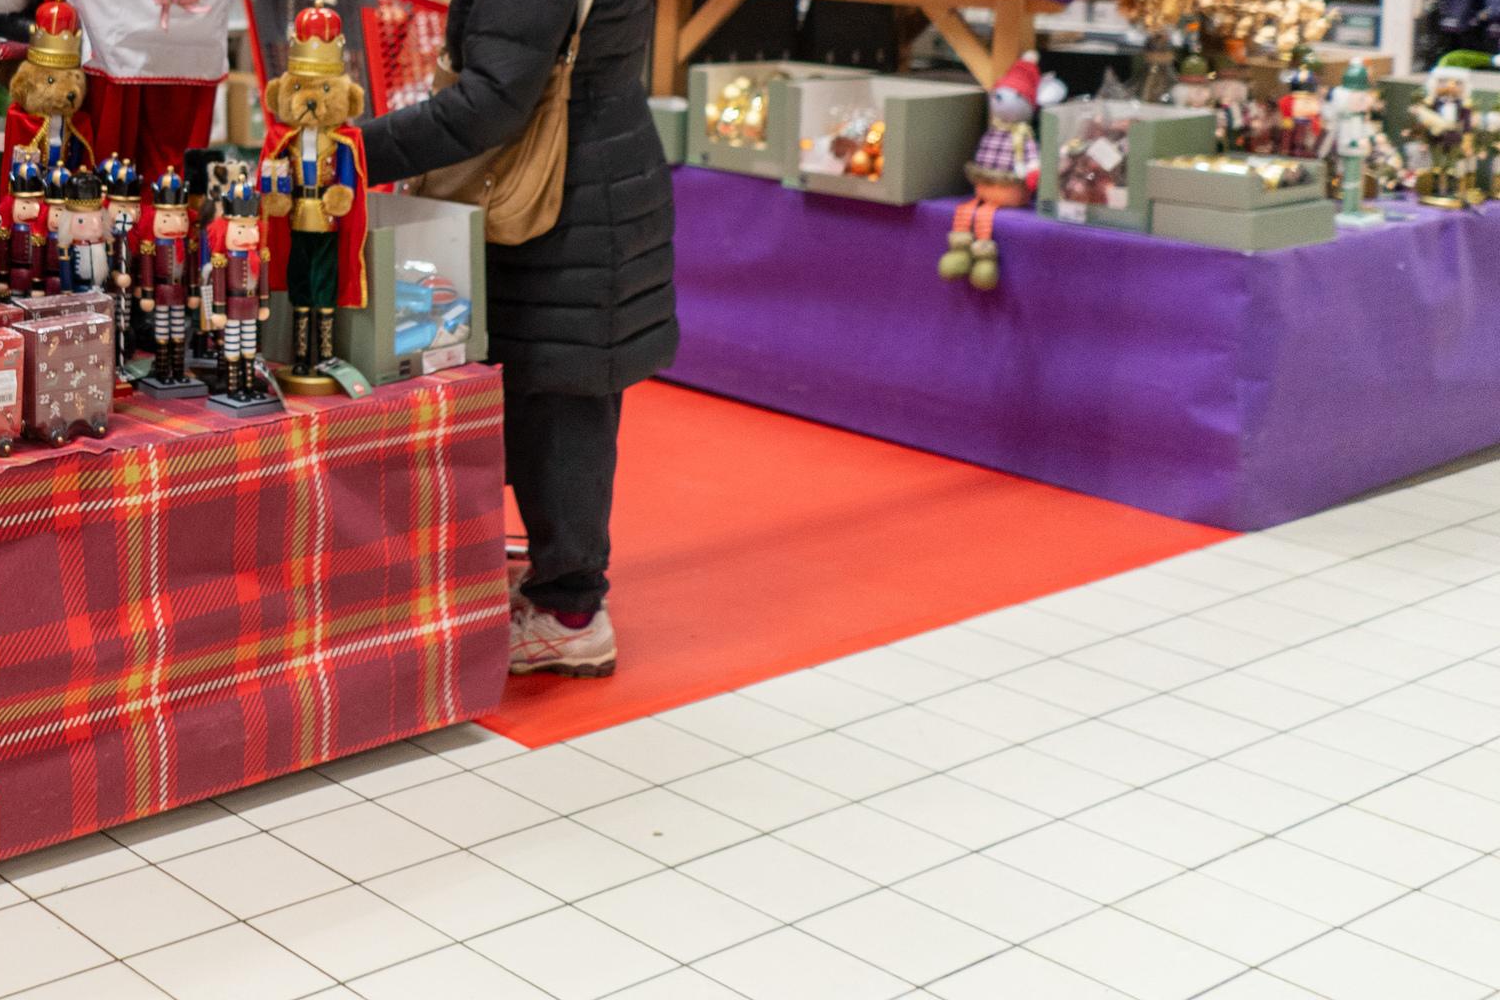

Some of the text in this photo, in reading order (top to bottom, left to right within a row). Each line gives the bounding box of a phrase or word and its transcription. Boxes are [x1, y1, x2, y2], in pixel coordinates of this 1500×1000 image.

[64, 361, 74, 372] 20
[88, 354, 98, 365] 21
[40, 394, 50, 405] 22
